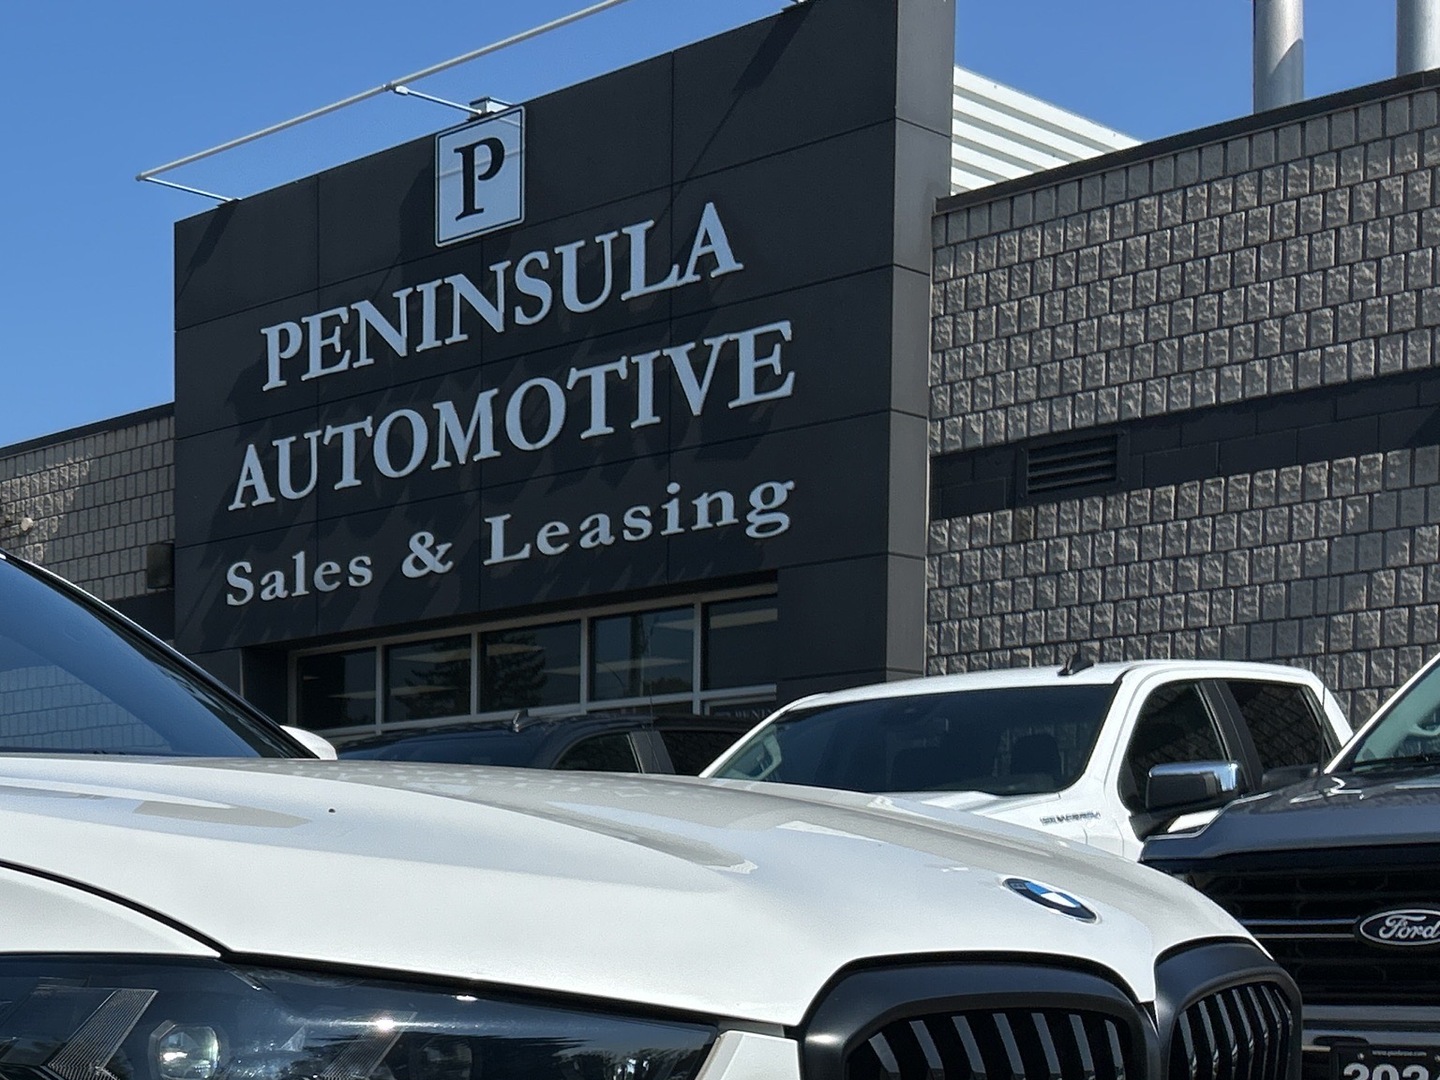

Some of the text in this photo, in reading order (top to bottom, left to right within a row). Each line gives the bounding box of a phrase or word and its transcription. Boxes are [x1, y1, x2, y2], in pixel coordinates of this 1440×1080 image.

[455, 135, 505, 221] P
[260, 201, 745, 393] PENINSULA
[226, 319, 796, 513] AUTOMOTIVE
[225, 479, 795, 607] Sales & Leasing
[1378, 914, 1440, 940] Ford
